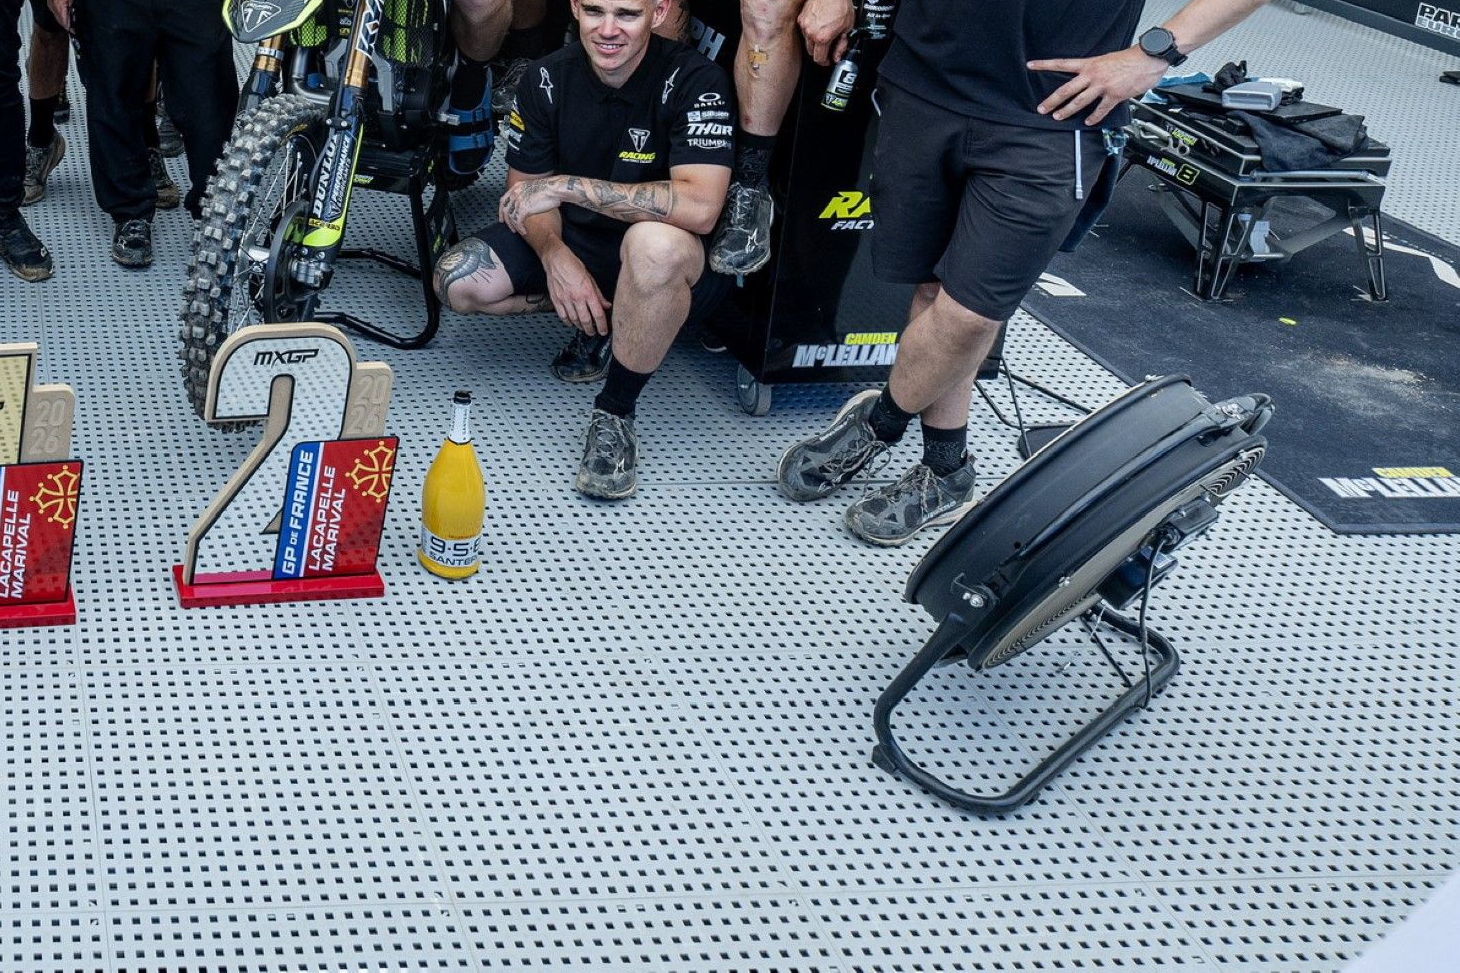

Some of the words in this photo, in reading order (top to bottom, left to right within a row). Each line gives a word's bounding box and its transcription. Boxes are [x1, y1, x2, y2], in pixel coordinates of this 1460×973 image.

[687, 122, 733, 136] THOR
[618, 150, 657, 161] RACING
[253, 348, 319, 367] MXGP
[844, 332, 898, 345] CAMDEN
[282, 547, 297, 575] GP
[291, 449, 314, 528] FRANCE
[309, 465, 336, 572] LACAPELLE
[322, 488, 346, 572] MARIVAL
[10, 512, 31, 599] MARIVAL
